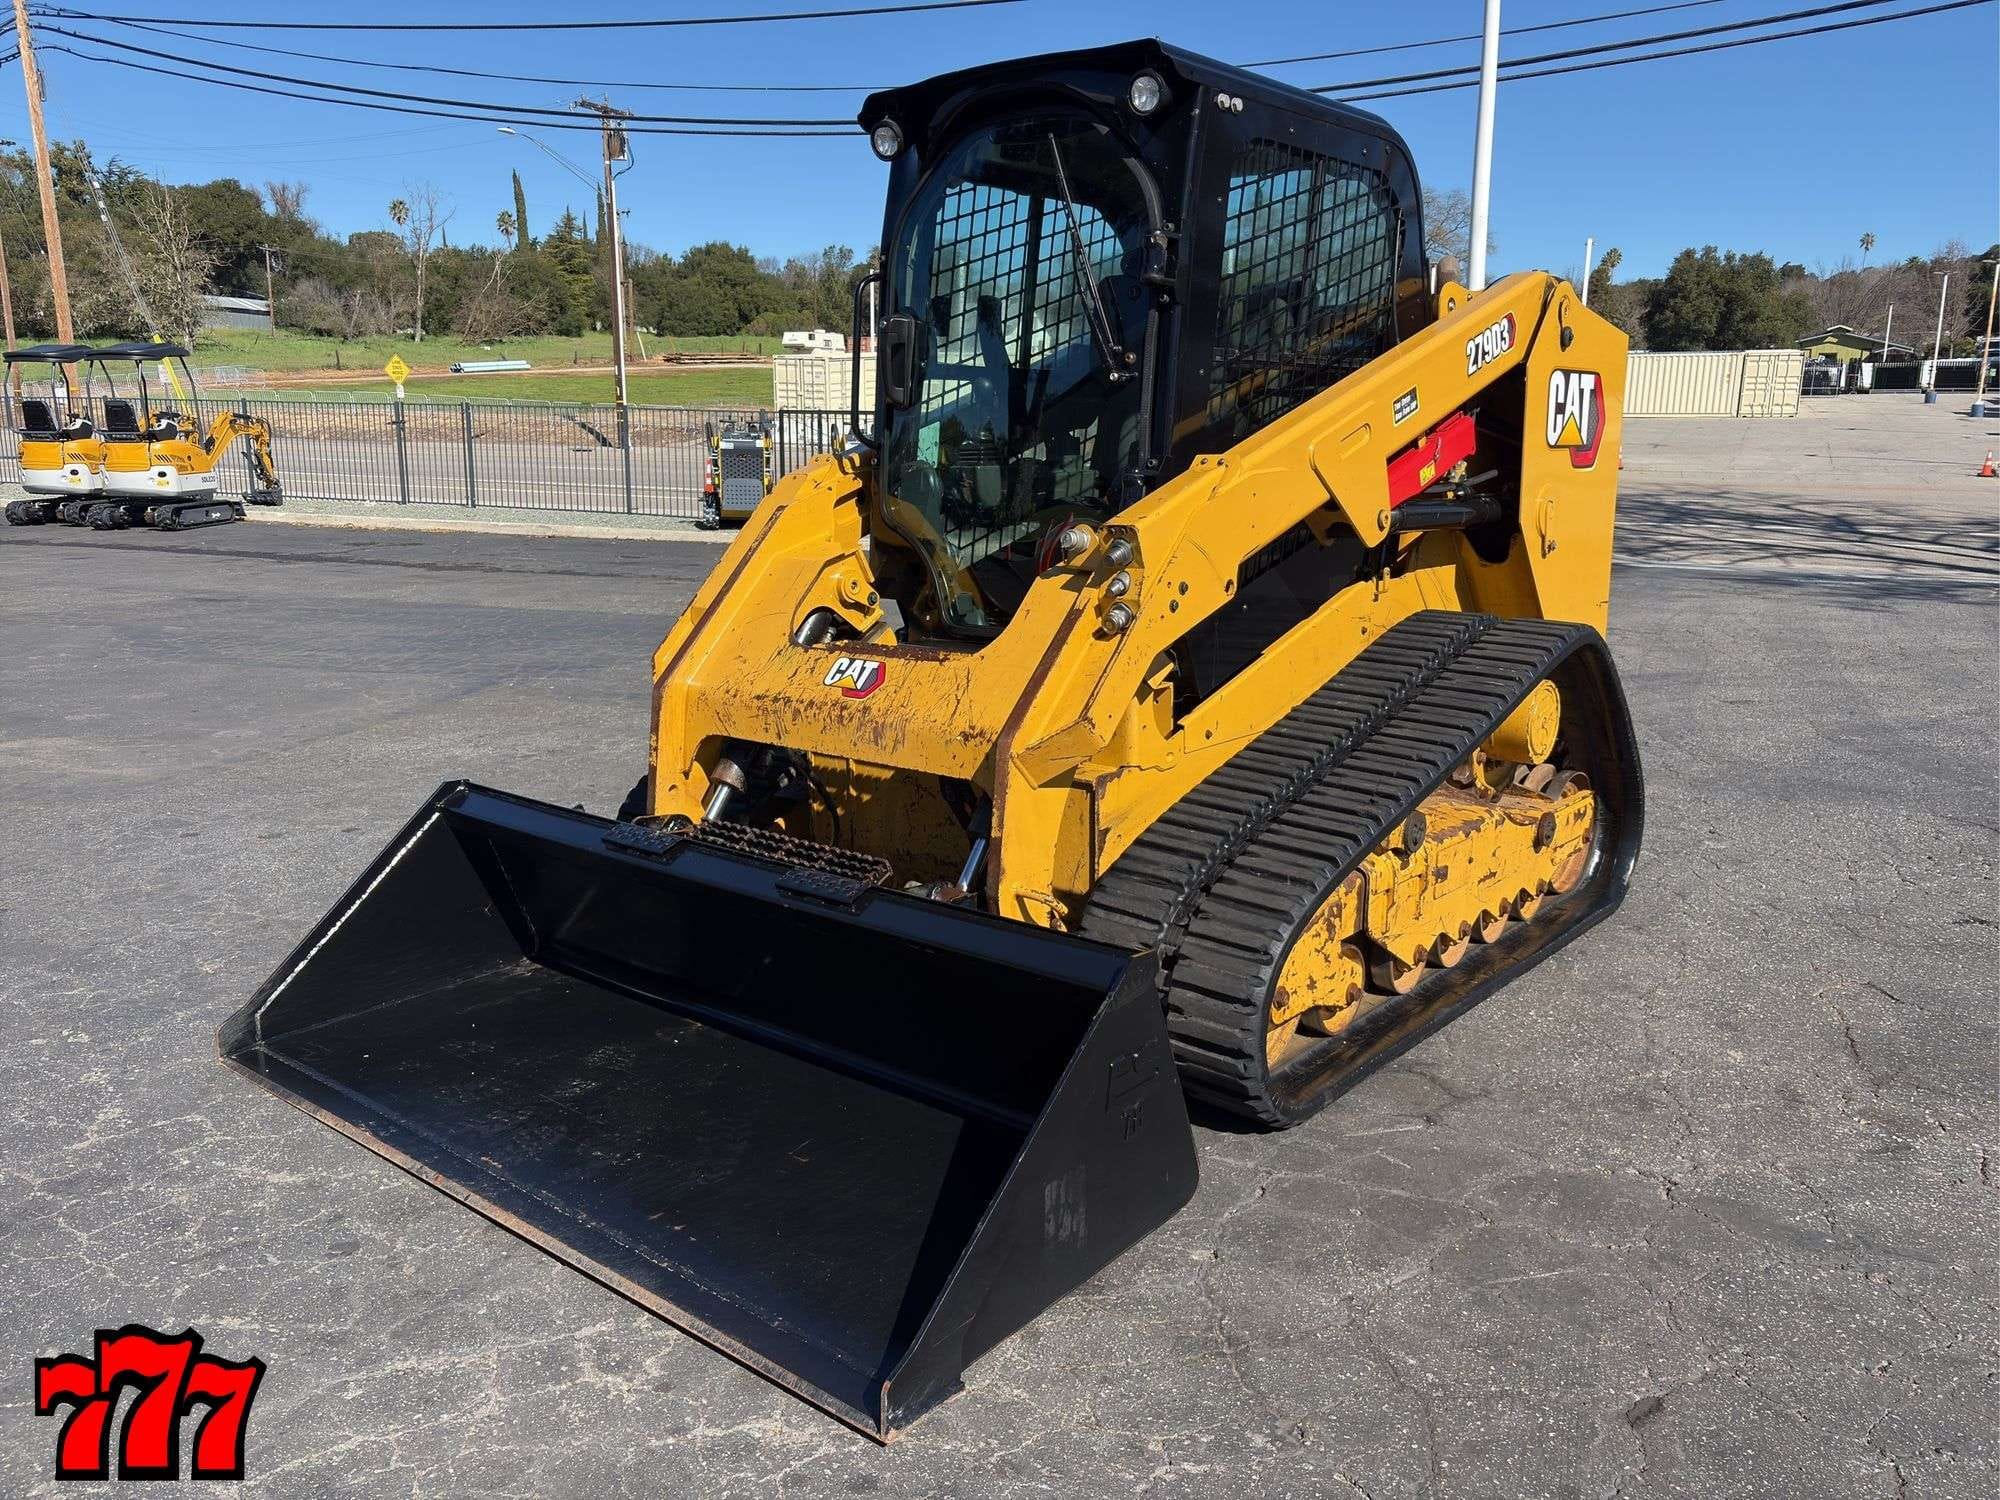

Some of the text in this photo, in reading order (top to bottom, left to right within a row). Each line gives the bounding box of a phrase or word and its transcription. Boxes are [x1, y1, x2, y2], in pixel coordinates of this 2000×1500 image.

[1466, 317, 1510, 376] 279D3
[1546, 369, 1596, 447] CAT
[823, 656, 881, 690] CAT
